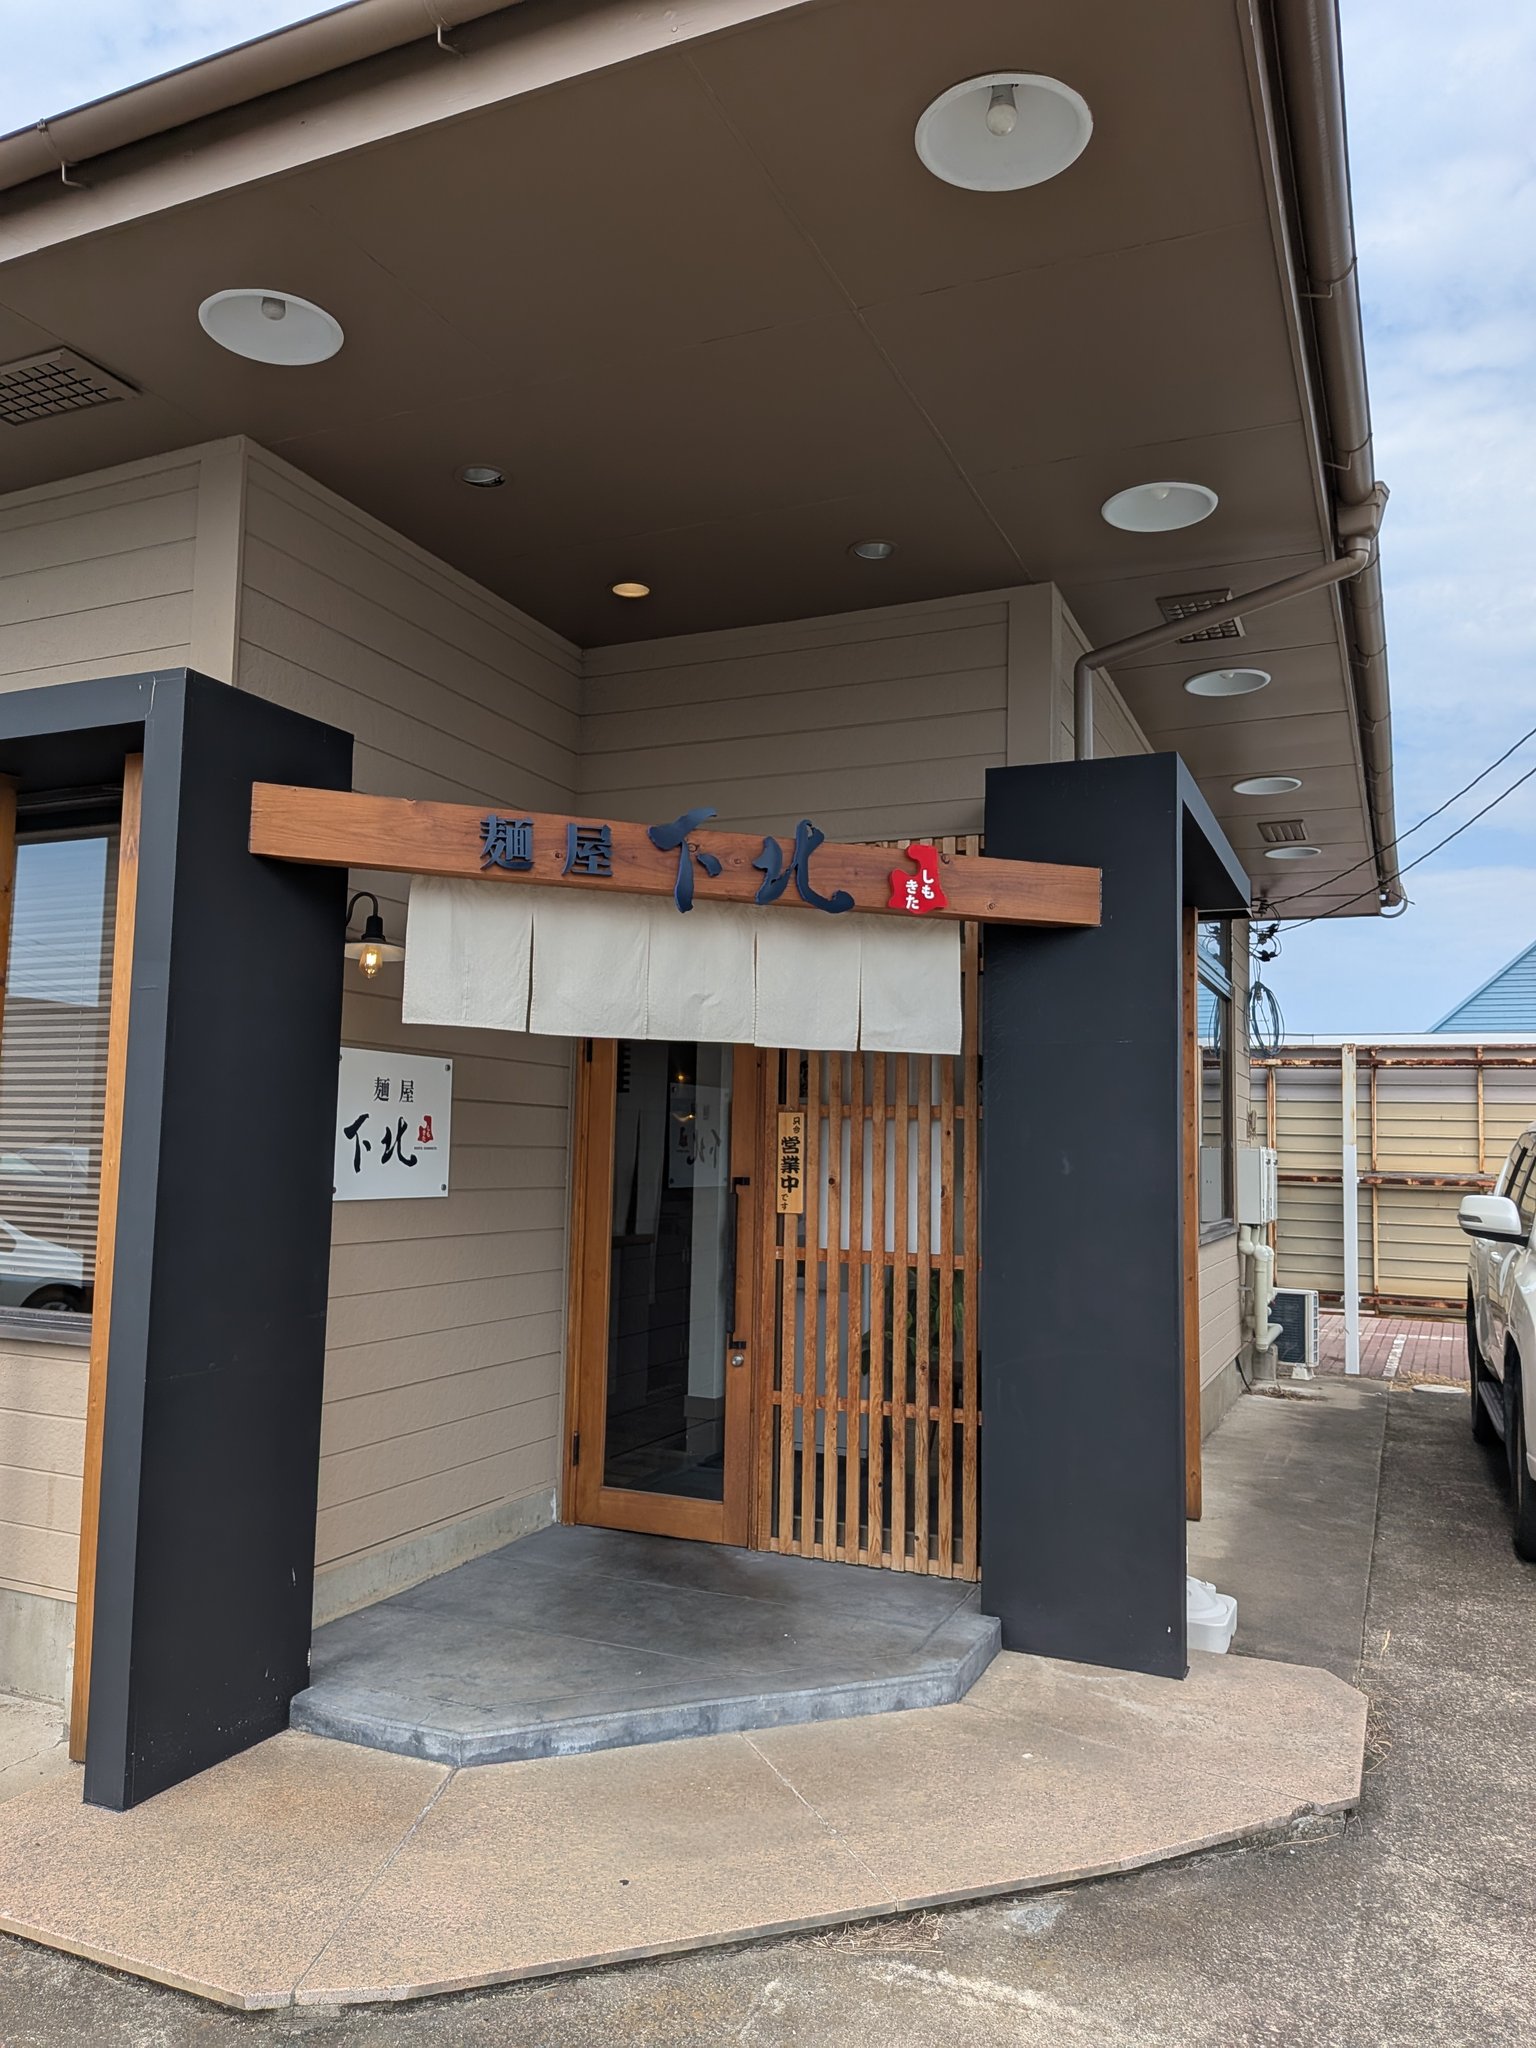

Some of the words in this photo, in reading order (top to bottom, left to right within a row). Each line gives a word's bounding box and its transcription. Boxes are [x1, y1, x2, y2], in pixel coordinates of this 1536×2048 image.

[479, 814, 613, 877] 麺屋
[647, 807, 855, 914] 下北
[905, 879, 920, 910] きた
[921, 869, 935, 900] しも
[374, 1077, 414, 1103] 麺屋
[343, 1113, 418, 1174] 下北
